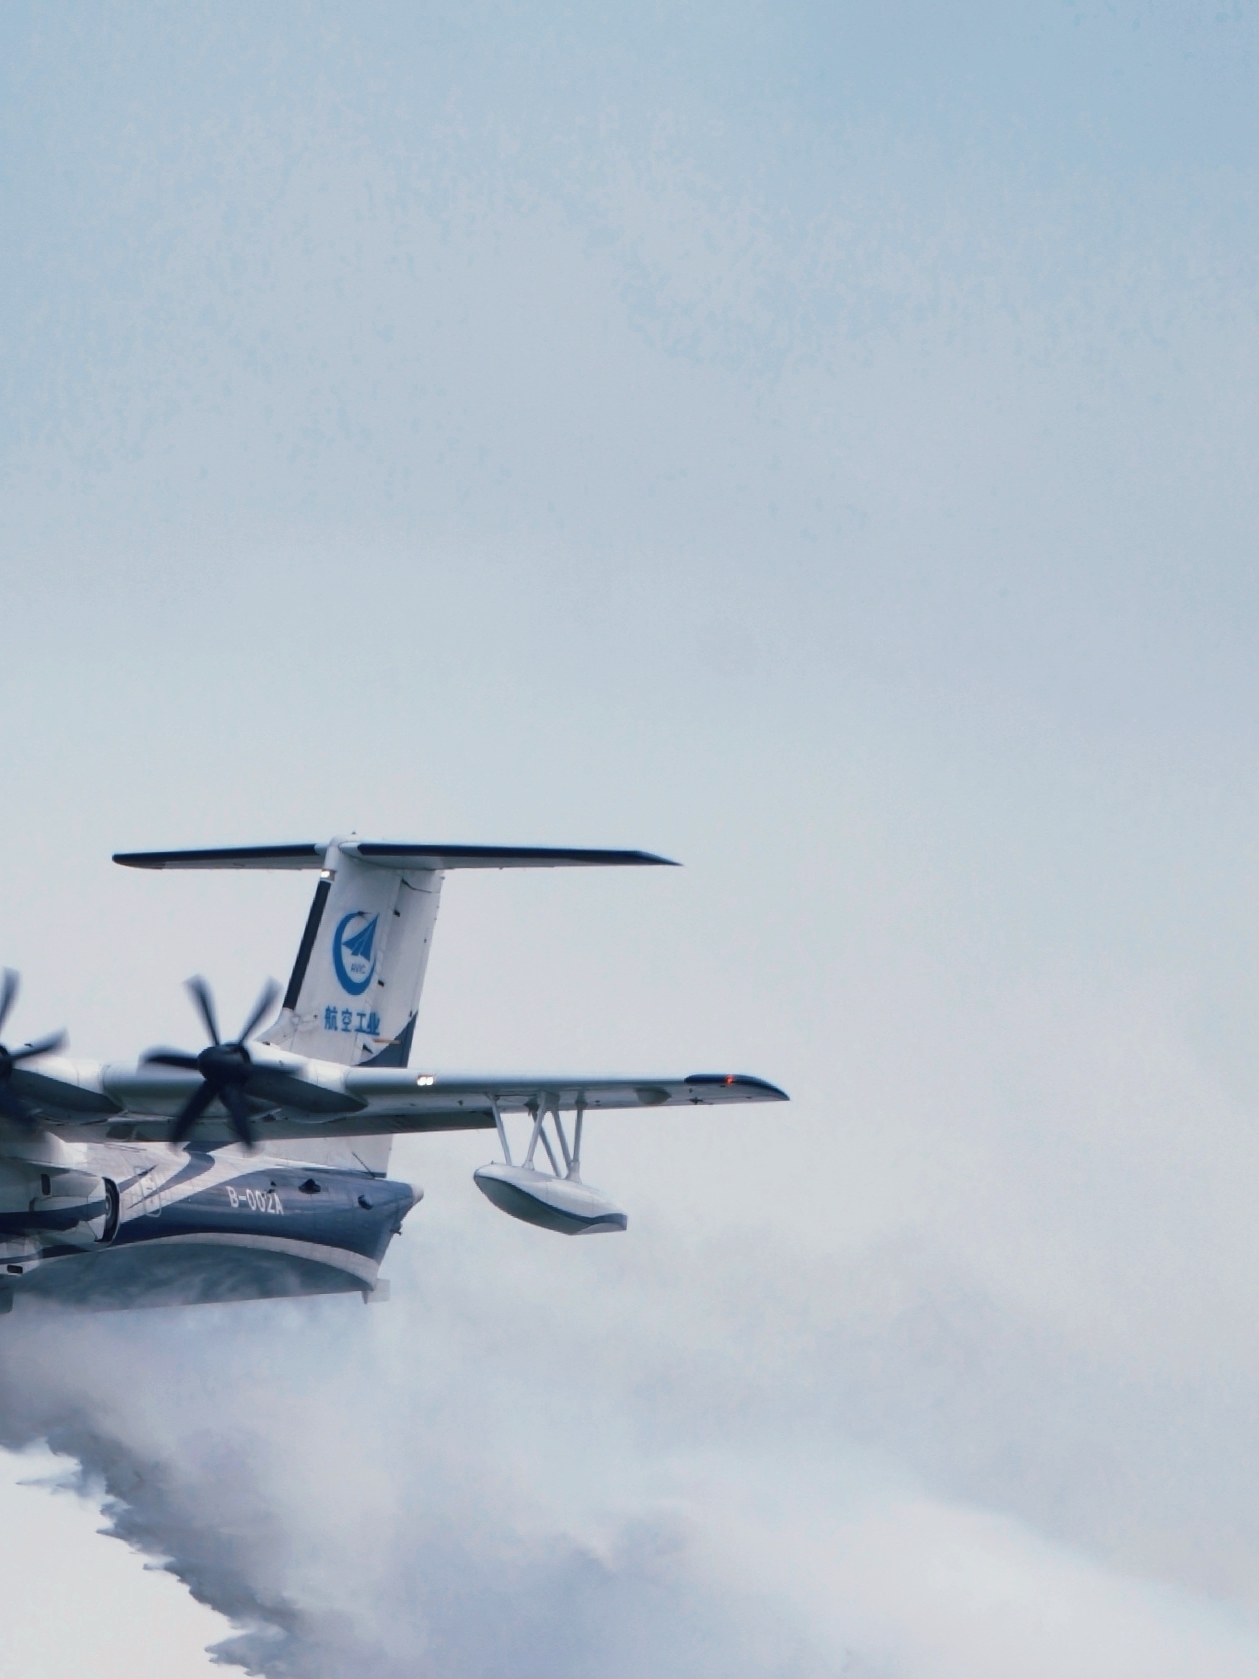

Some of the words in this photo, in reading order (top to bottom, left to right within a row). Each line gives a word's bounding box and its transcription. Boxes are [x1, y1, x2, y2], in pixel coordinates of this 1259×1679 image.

[324, 1005, 380, 1036] 航空工业
[225, 1185, 284, 1215] B-002A
